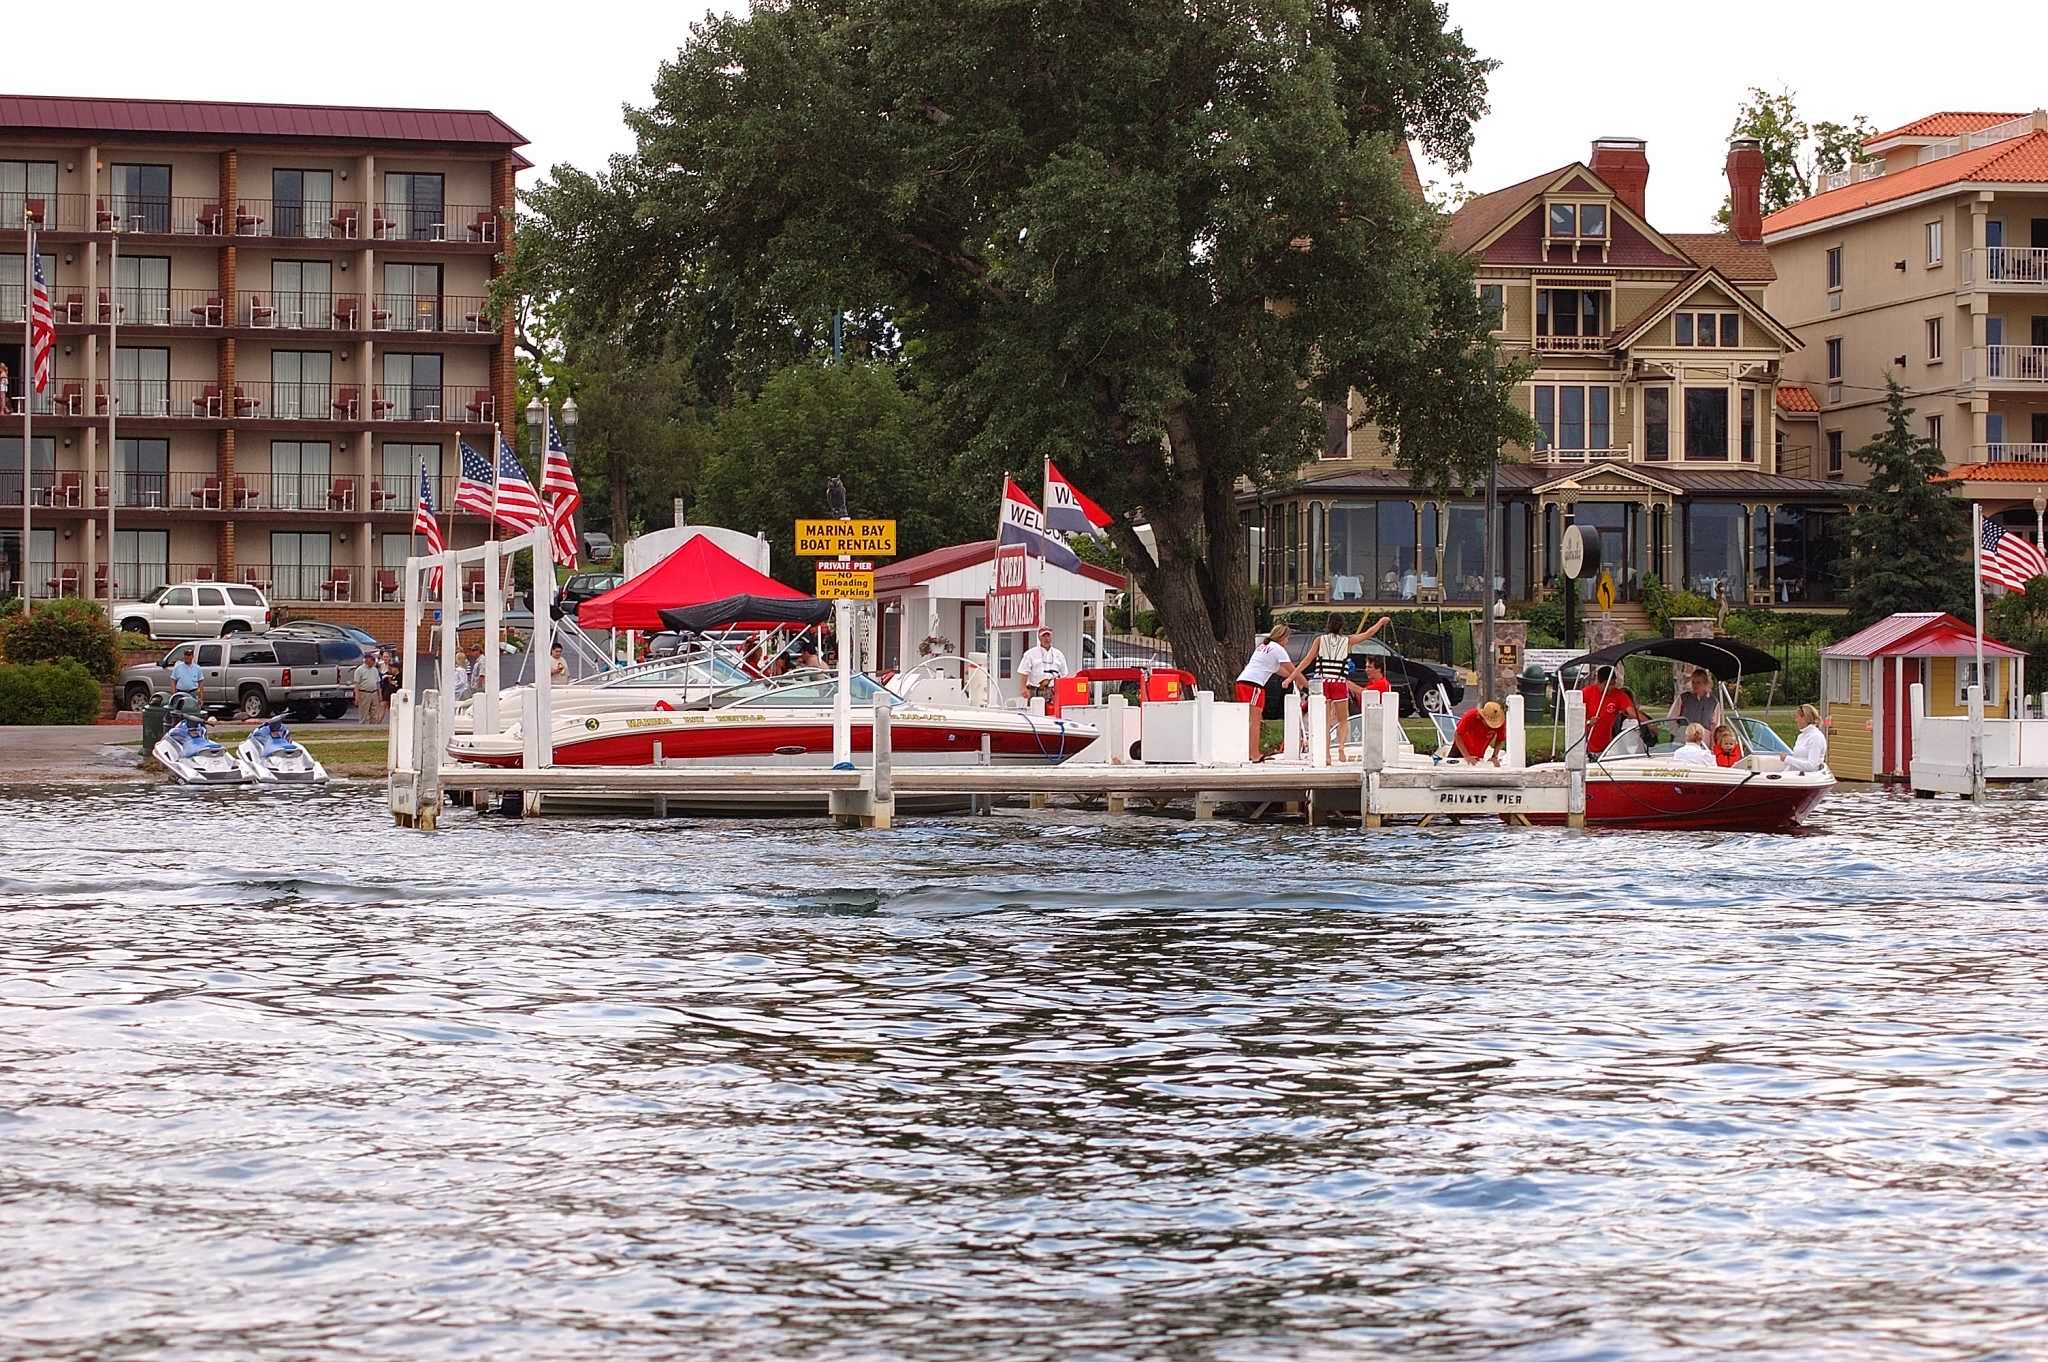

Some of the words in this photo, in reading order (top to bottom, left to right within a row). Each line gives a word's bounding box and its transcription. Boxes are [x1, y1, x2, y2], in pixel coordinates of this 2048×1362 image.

[806, 525, 855, 536] MARINA
[861, 525, 885, 536] BAY
[800, 539, 831, 550] BOAT
[838, 539, 892, 550] RENTALS
[818, 561, 851, 570] PRIVATE
[853, 561, 872, 570] PIER
[1000, 555, 1024, 588] SPEED
[822, 579, 868, 588] Unloading
[834, 588, 870, 597] Parking
[1005, 591, 1035, 626] RENTALS
[587, 719, 597, 731] 3
[1440, 793, 1488, 804] PRIVATE
[1497, 794, 1522, 804] PIER
